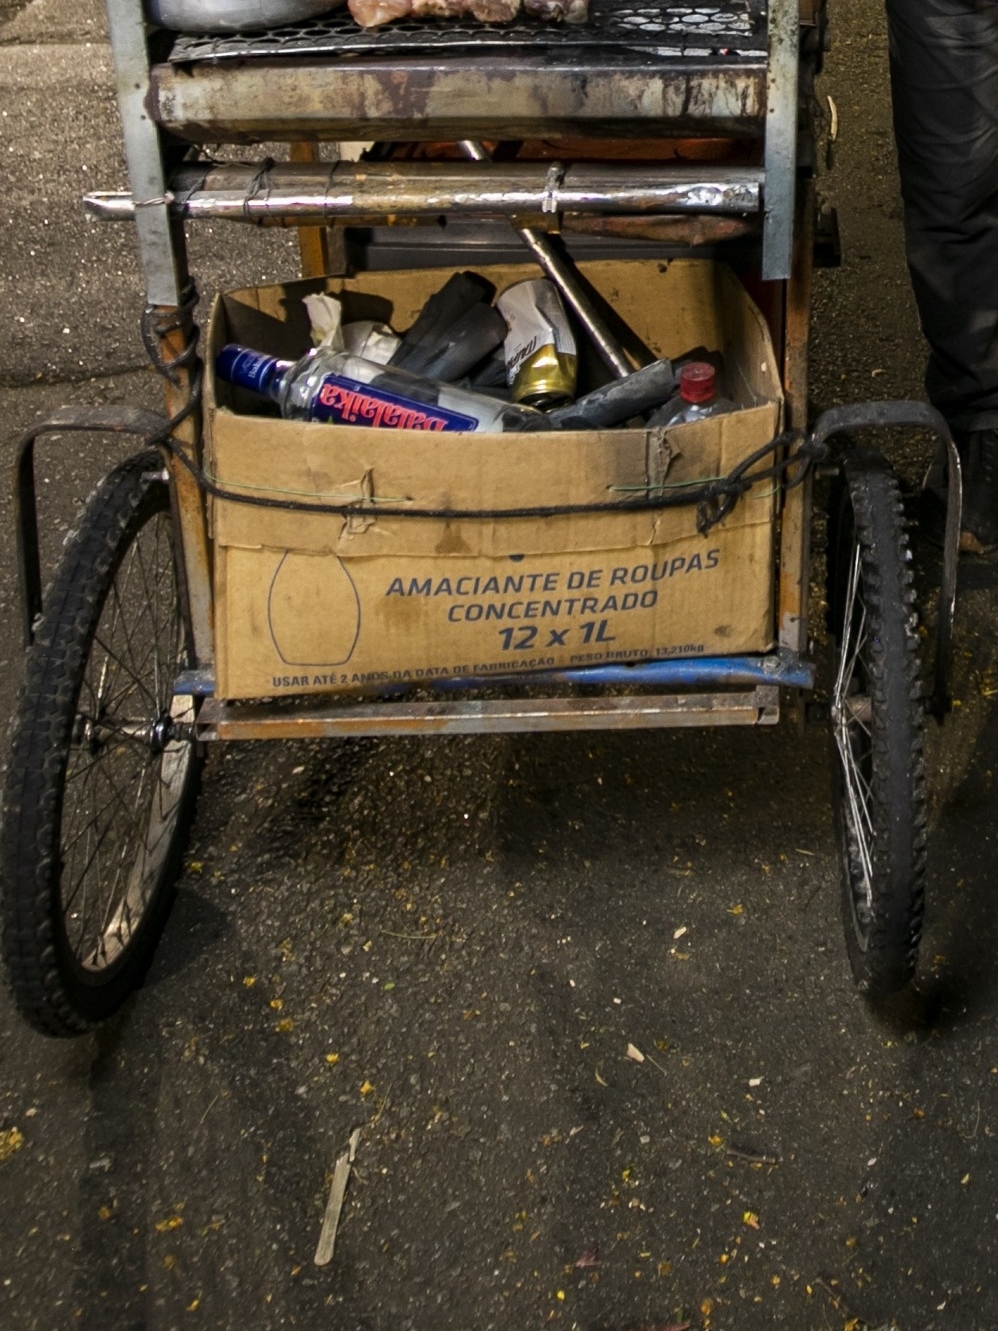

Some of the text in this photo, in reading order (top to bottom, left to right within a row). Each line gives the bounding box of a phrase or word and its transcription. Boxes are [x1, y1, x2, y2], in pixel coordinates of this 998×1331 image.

[385, 548, 720, 597] AMACIANTE DE ROUPAS
[447, 590, 658, 623] CONCENTRADO
[498, 619, 617, 652] 12 x 1L
[272, 675, 309, 688] USAR
[313, 671, 337, 686] ATÉ
[341, 674, 349, 684] 2
[351, 671, 389, 682] ANOS
[391, 670, 412, 680] DA
[415, 667, 449, 678] DATA
[452, 665, 470, 675] DE
[473, 656, 556, 673] FABRICAÇÃO
[569, 653, 602, 663] PESO
